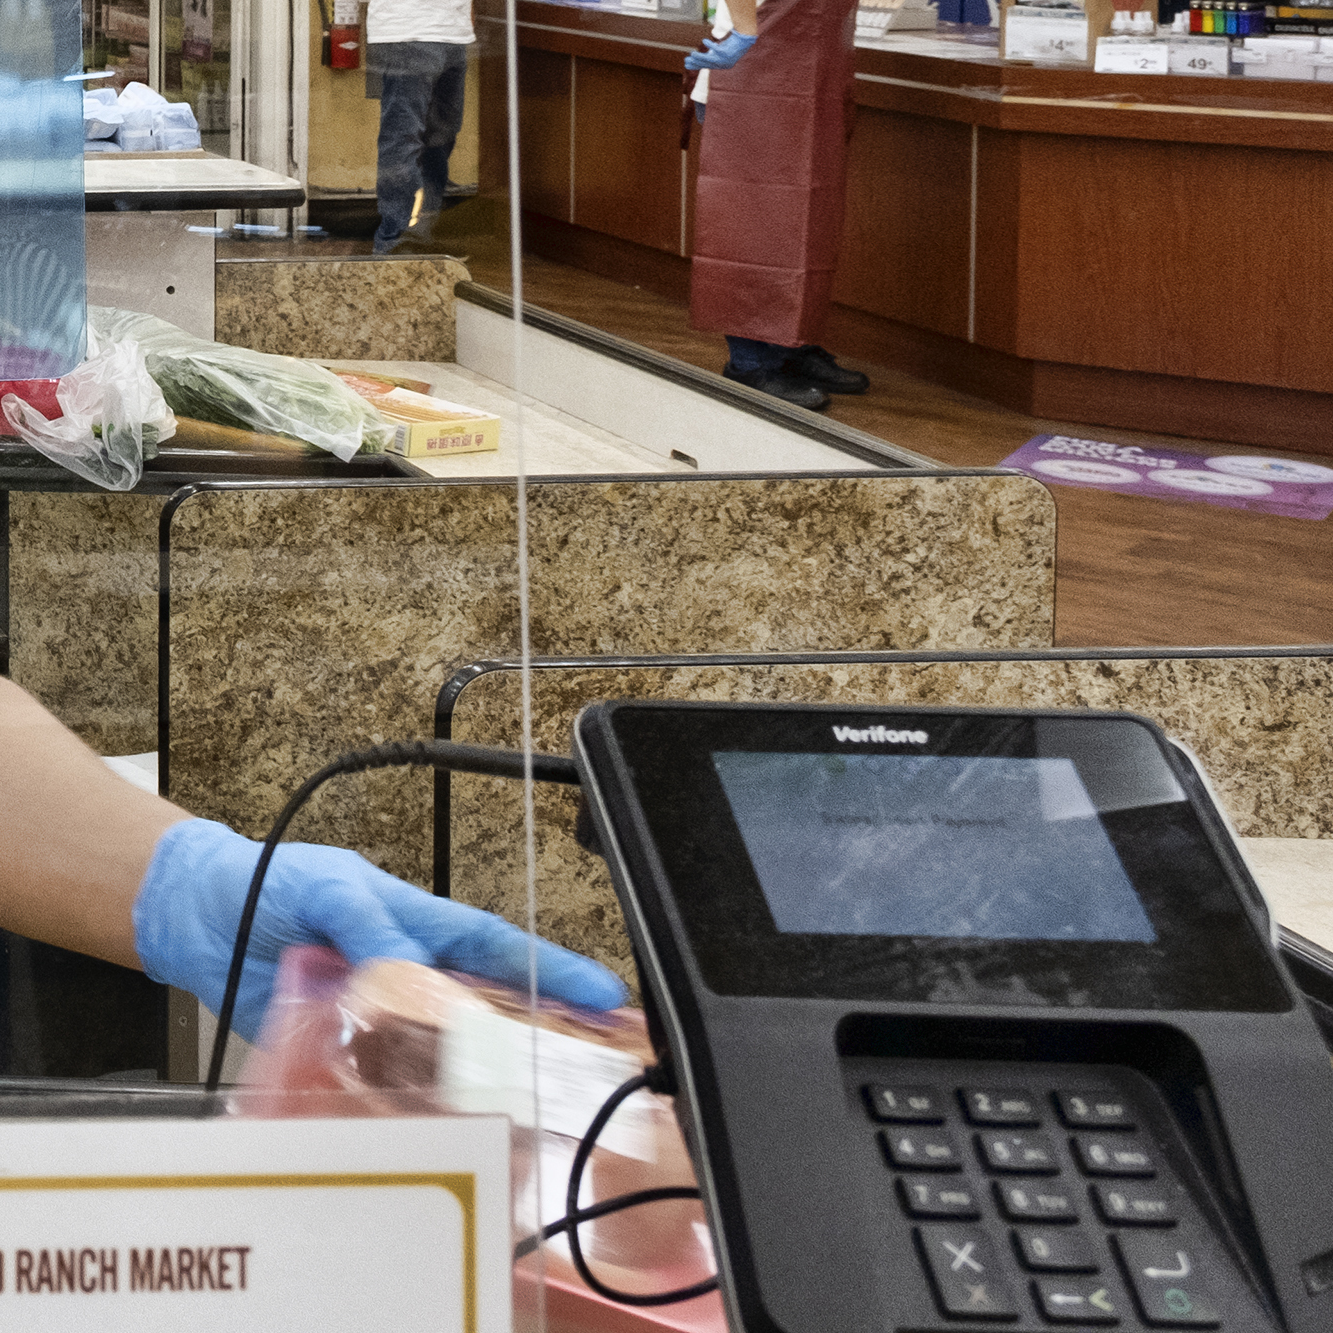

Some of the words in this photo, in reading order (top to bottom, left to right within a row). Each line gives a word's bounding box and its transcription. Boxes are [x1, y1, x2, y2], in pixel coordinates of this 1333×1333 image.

[832, 724, 929, 745] Verifone
[884, 1090, 896, 1108] 1
[974, 1092, 992, 1112] 2
[1070, 1096, 1088, 1115] 3
[913, 1184, 929, 1204] 7
[15, 1246, 119, 1296] RANCH
[127, 1245, 251, 1293] MARKET
